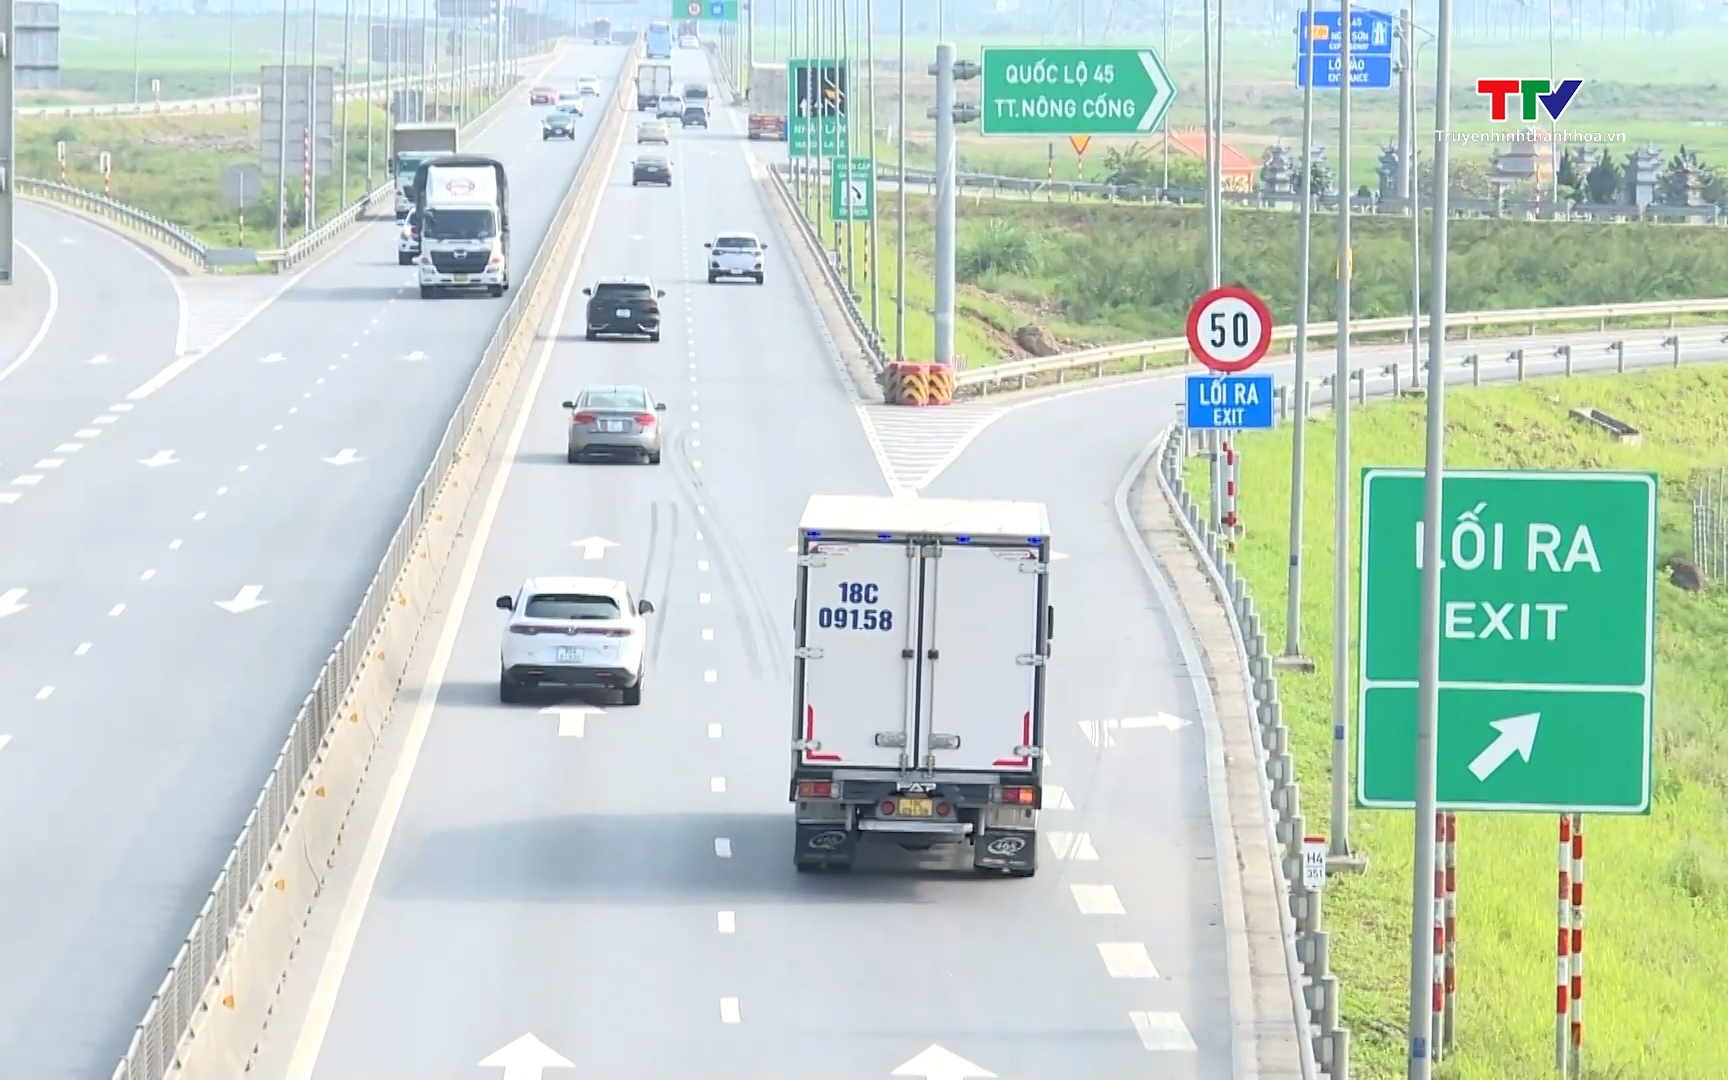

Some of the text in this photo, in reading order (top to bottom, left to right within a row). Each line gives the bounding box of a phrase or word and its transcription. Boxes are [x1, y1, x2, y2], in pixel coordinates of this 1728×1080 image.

[1006, 58, 1115, 88] QUỐC LỘ 45
[994, 92, 1136, 118] TT.NÔNG CỐNG
[1211, 312, 1249, 348] 50
[1200, 374, 1260, 406] LỐI RA
[1213, 408, 1245, 426] EXIT
[1527, 522, 1602, 573] RA
[838, 582, 879, 604] 18C
[1445, 601, 1569, 641] EXIT
[1307, 851, 1323, 864] H4
